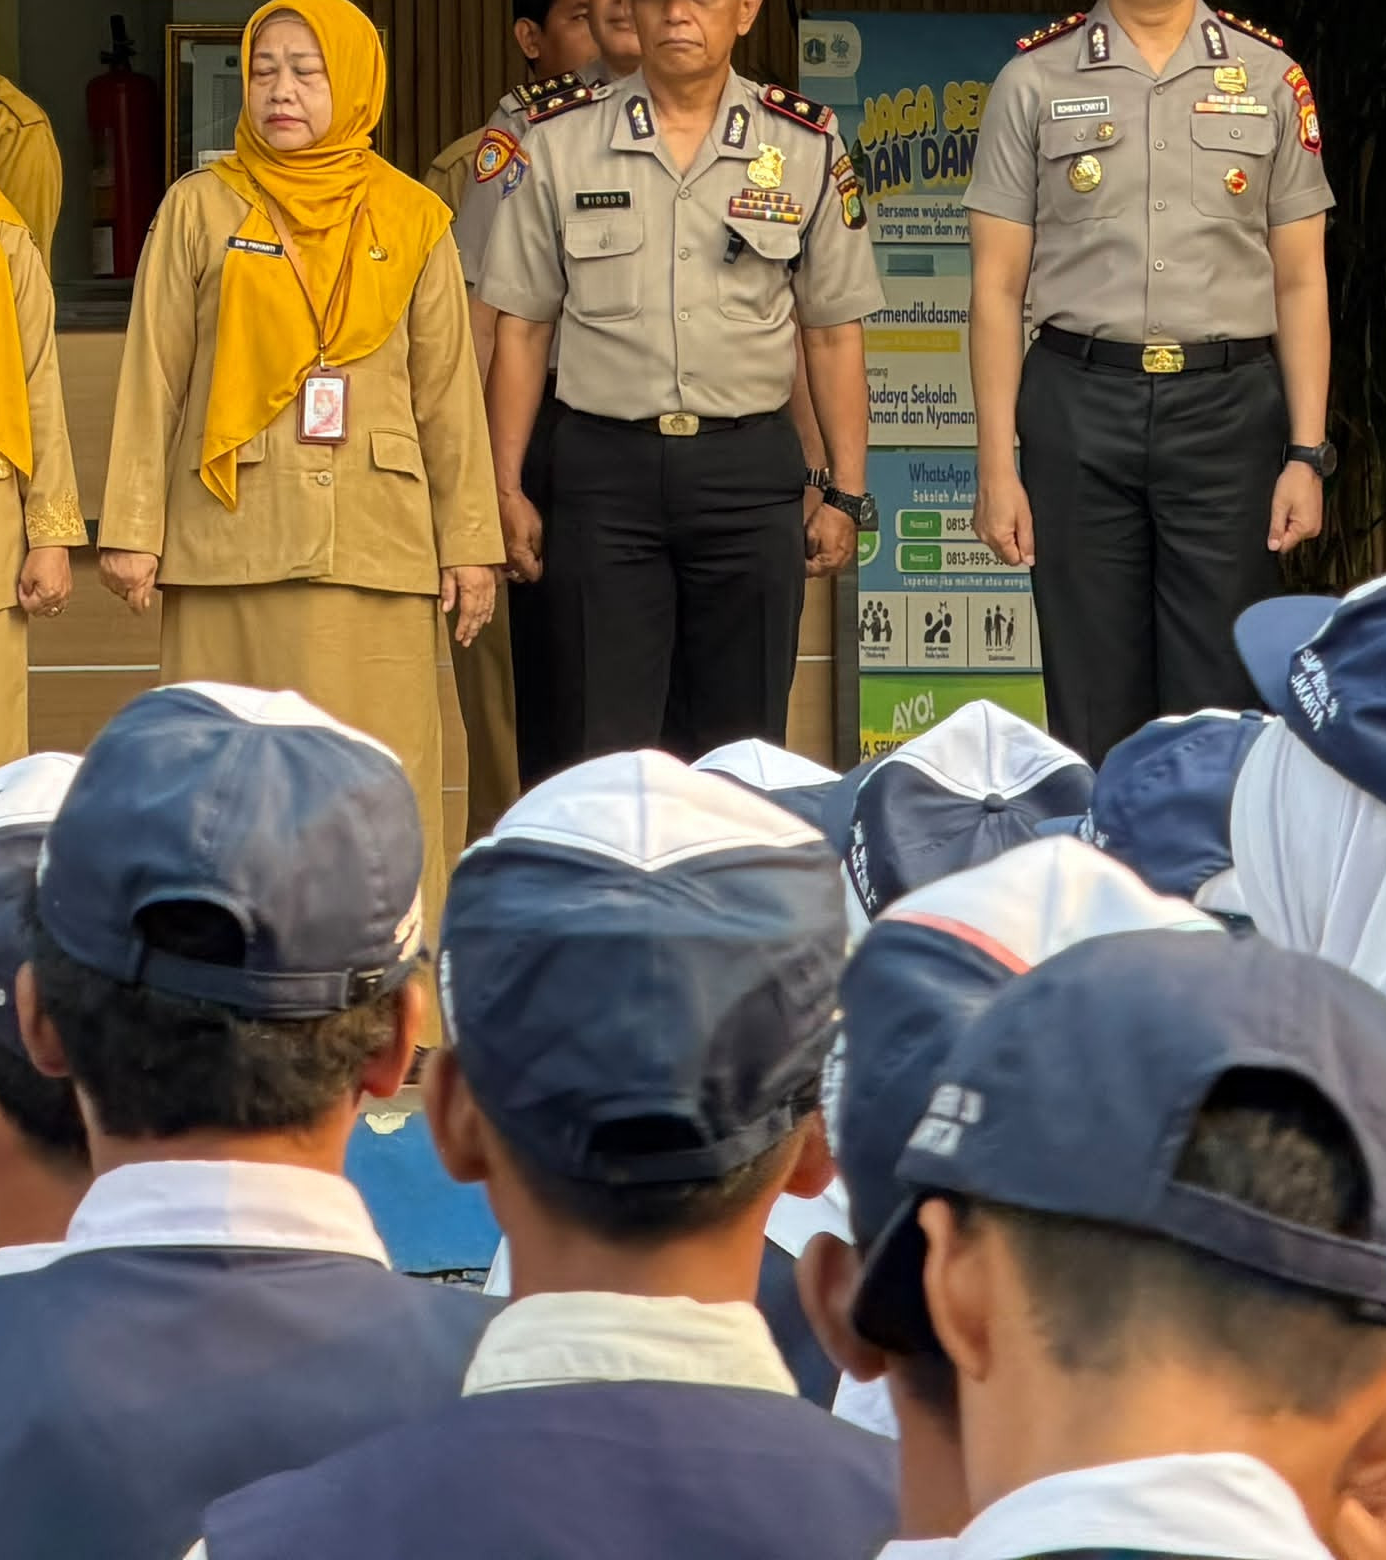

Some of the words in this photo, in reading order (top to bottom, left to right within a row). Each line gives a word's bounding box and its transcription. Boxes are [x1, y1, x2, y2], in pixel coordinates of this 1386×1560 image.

[858, 83, 938, 151] JAGA
[876, 203, 919, 219] Bersama
[880, 224, 904, 239] yang
[906, 224, 932, 236] aman
[935, 220, 953, 236] dan
[912, 383, 958, 404] Sekolah
[901, 405, 924, 424] dan
[926, 404, 976, 430] Nyaman
[908, 461, 971, 489] WhatsApp
[892, 689, 936, 736] AYO!
